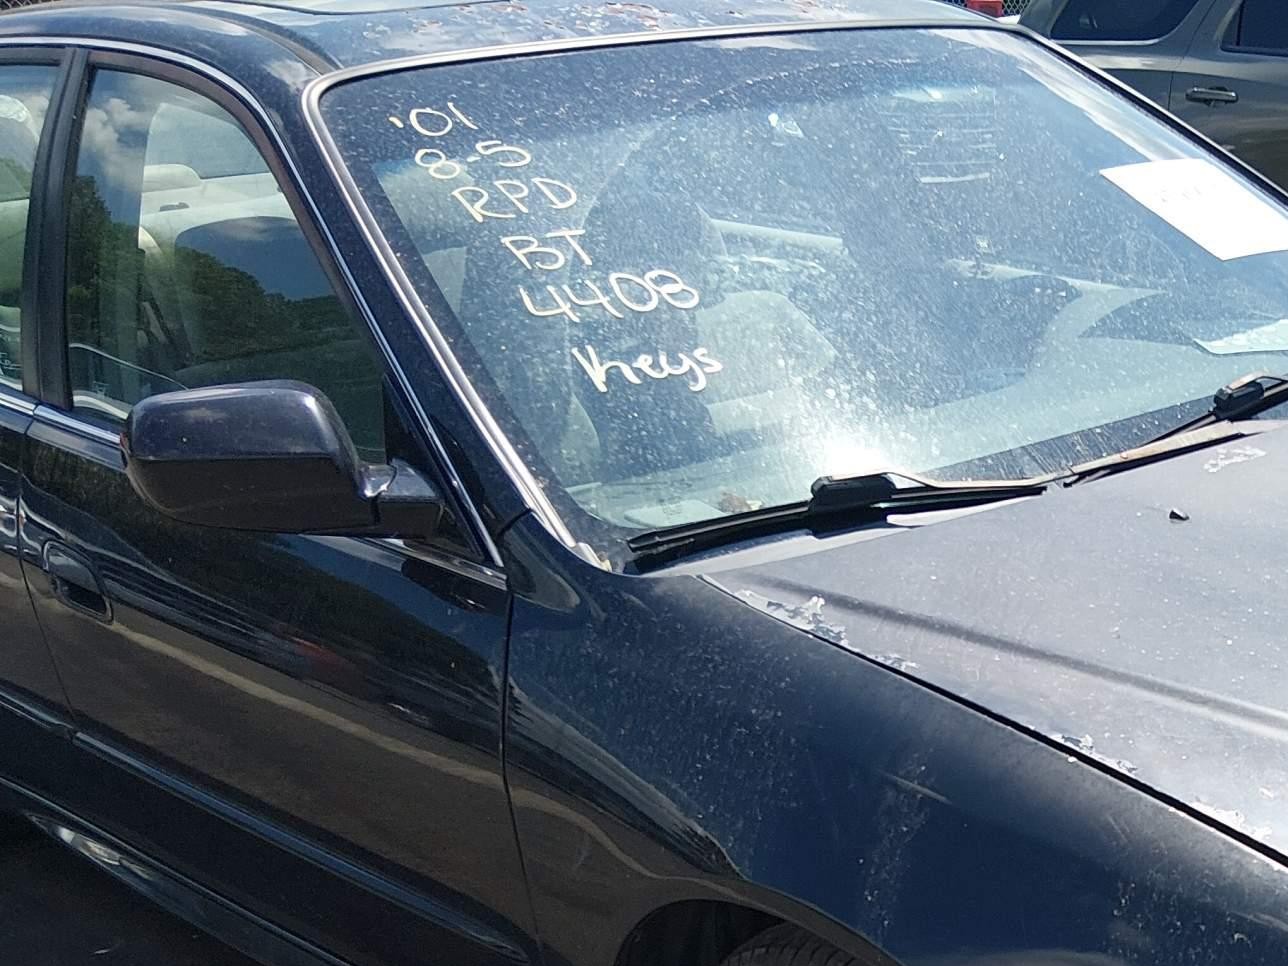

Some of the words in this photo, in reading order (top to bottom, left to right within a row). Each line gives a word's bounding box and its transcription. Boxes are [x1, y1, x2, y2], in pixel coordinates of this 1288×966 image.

[415, 140, 531, 179] 8-5
[452, 177, 577, 222] RPD
[501, 229, 593, 270] BT
[519, 269, 700, 323] 4408
